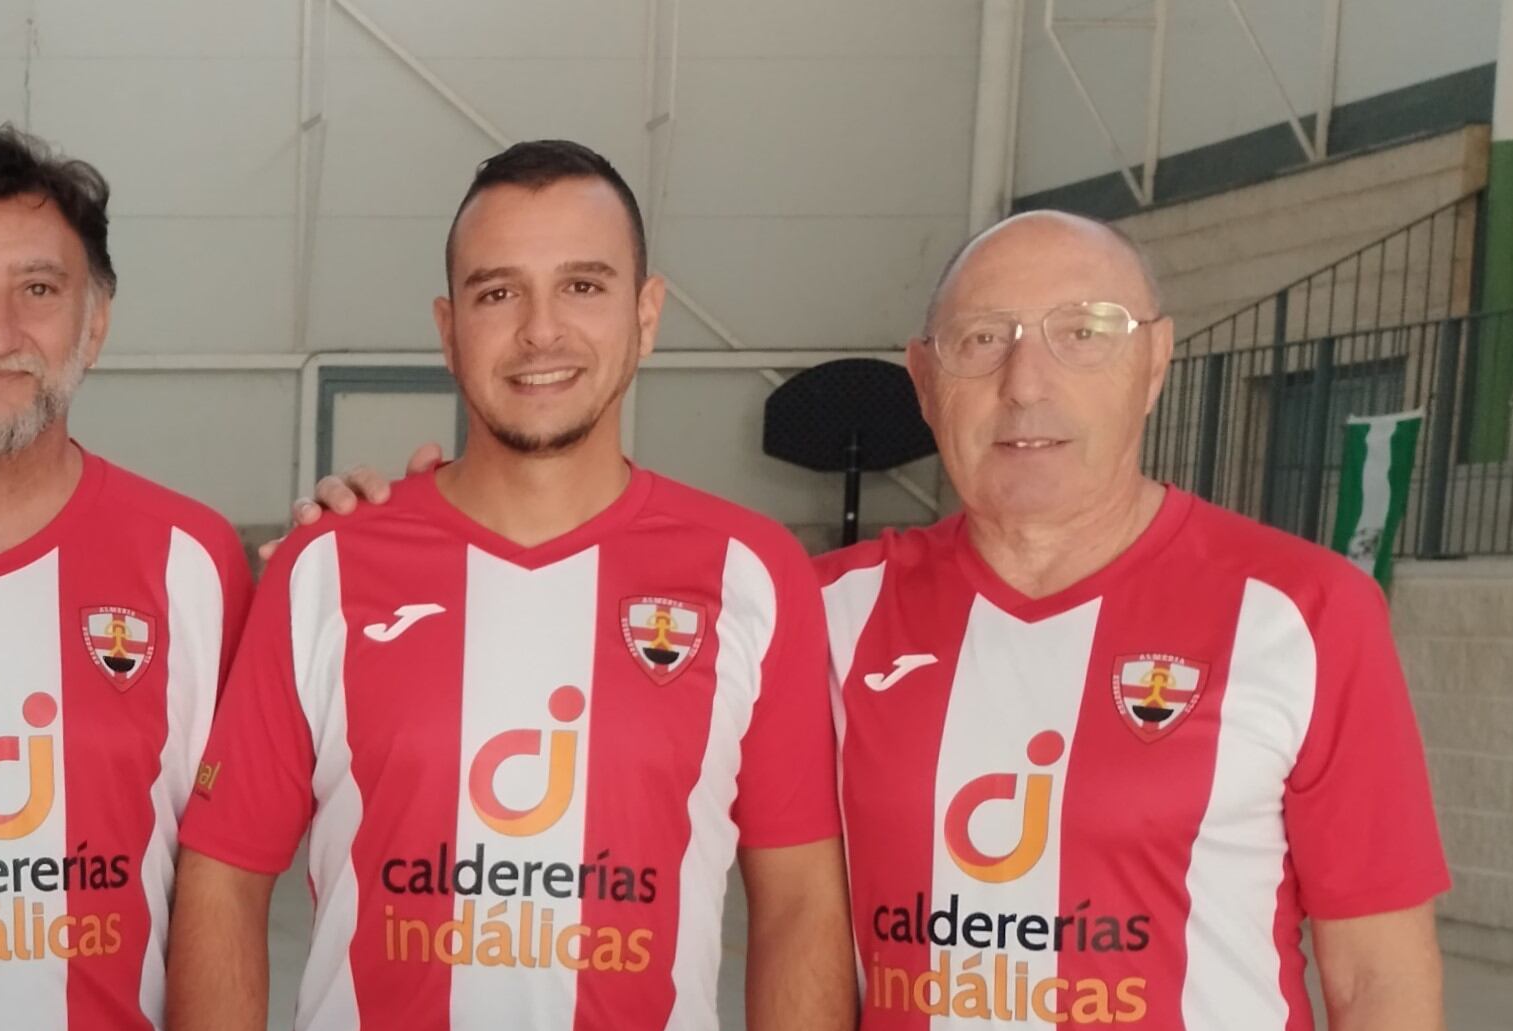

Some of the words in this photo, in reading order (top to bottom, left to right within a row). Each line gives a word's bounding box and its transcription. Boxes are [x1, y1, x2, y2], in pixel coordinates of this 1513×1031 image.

[381, 842, 658, 904] caldererías
[384, 899, 654, 973] indálicas
[872, 891, 1152, 954] caldererías
[872, 950, 1148, 1024] indálicas
